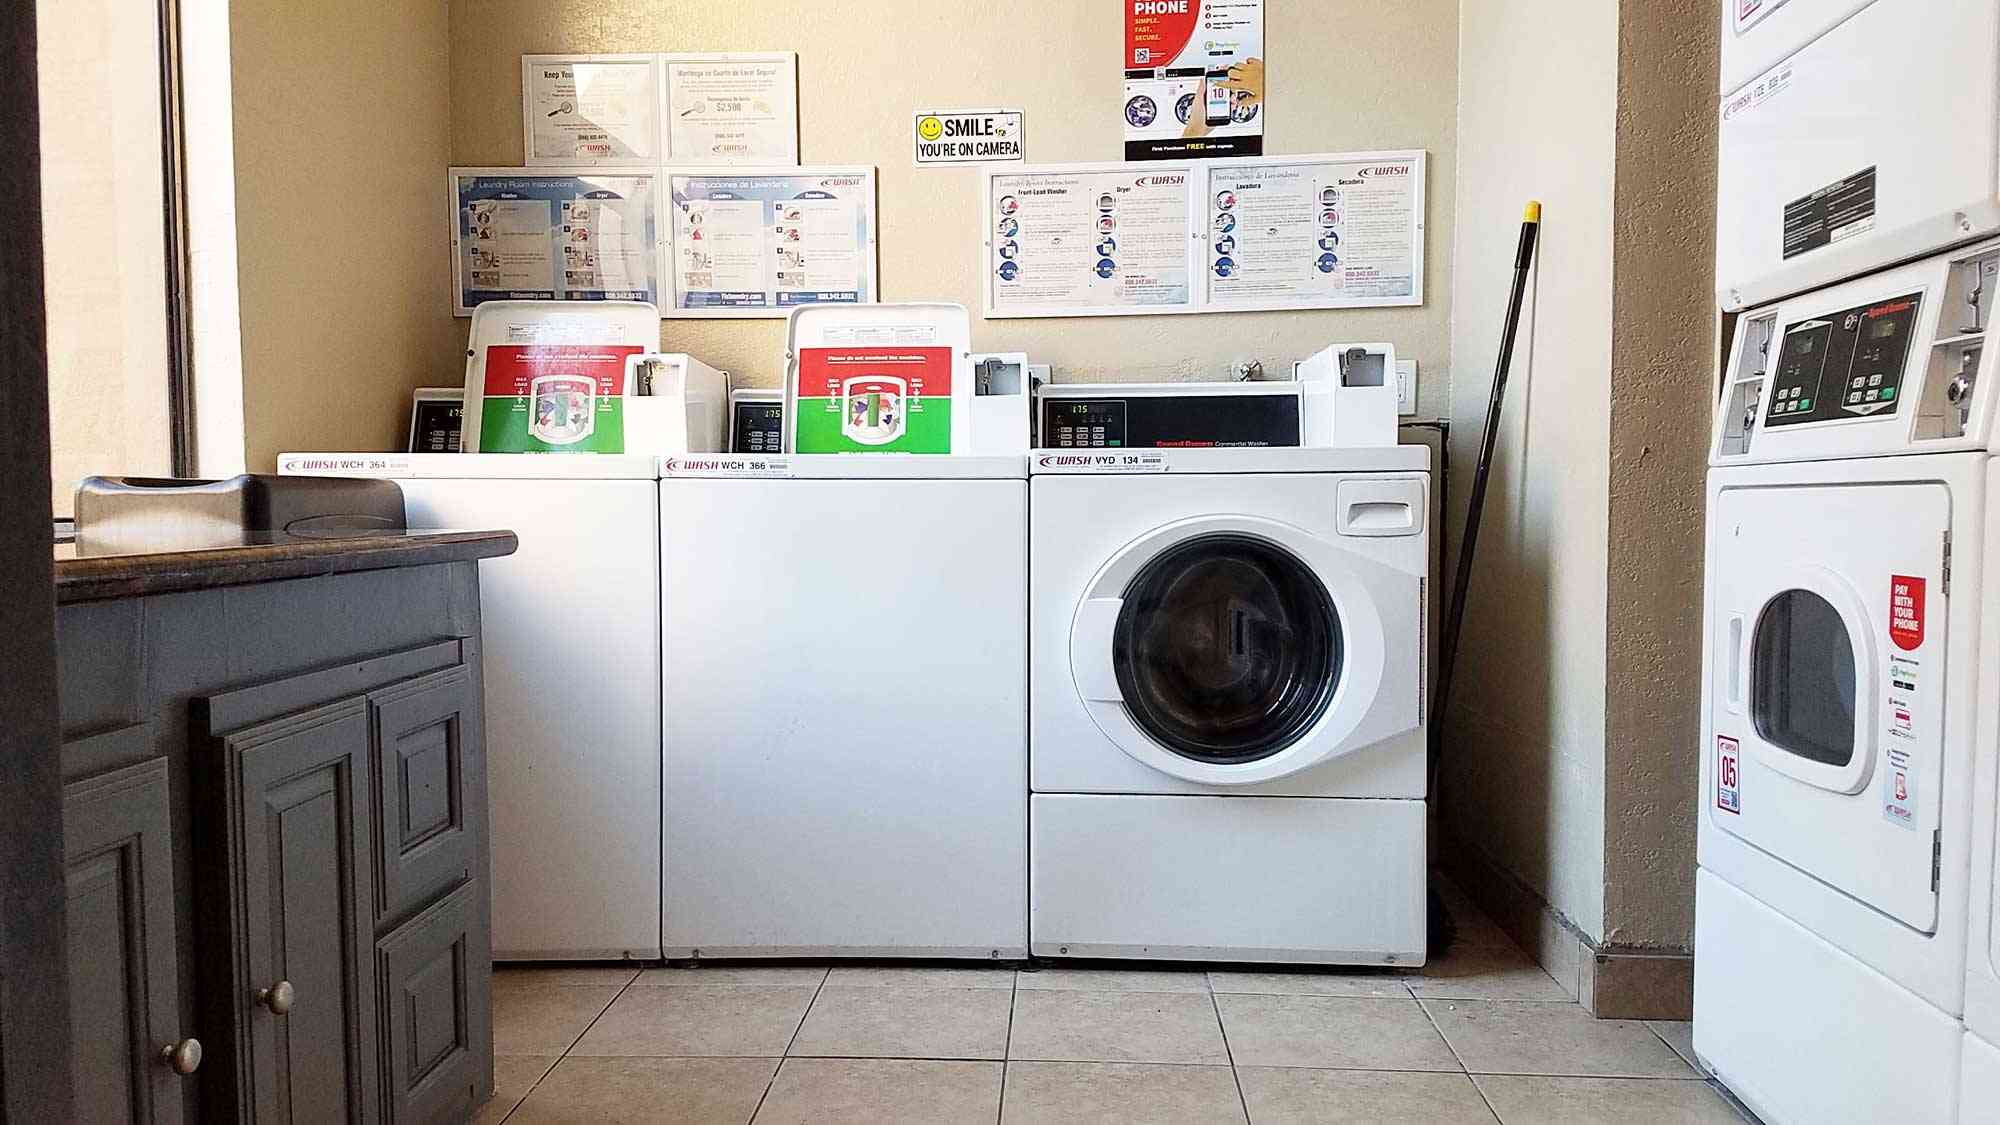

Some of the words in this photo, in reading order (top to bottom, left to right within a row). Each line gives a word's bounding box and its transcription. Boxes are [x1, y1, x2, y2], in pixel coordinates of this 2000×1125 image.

[1135, 1, 1188, 15] PHONE
[544, 70, 560, 80] Keep
[561, 70, 575, 79] You
[1213, 88, 1224, 99] 10
[945, 118, 994, 136] SMILE
[919, 143, 956, 157] YOU'RE
[959, 142, 973, 156] ON
[976, 141, 1019, 156] CAMERA
[1374, 166, 1409, 176] WASH
[833, 178, 860, 186] WASH
[1151, 175, 1184, 185] WASH
[303, 460, 338, 469] WASH
[340, 460, 364, 469] WCH
[369, 460, 386, 469] 364
[684, 461, 719, 470] WASH
[721, 461, 744, 470] WCH
[749, 461, 765, 470] 366
[1056, 456, 1091, 465] WASH
[1095, 456, 1115, 464] VYD
[1123, 456, 1138, 464] 134
[1895, 584, 1908, 595] PAY
[1895, 595, 1913, 607] WITH
[1894, 606, 1914, 619] YOUR
[1893, 617, 1919, 631] PHONE
[1722, 755, 1736, 789] 05
